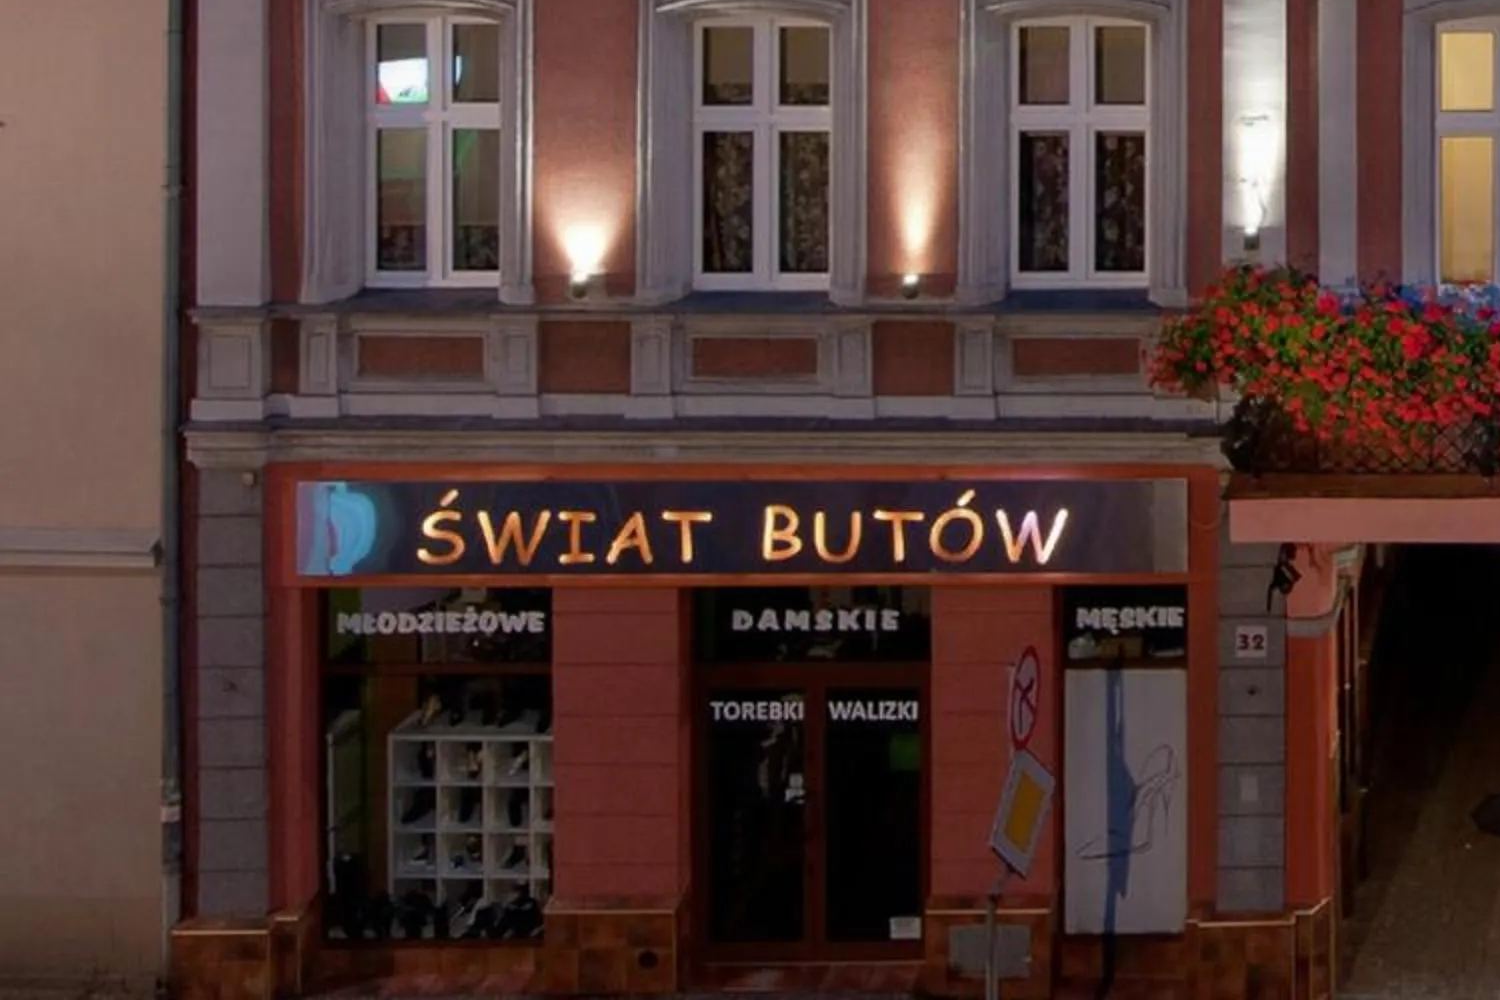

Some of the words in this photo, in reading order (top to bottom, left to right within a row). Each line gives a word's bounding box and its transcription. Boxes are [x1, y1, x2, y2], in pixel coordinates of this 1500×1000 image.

[416, 488, 713, 566] ŚWIAT
[762, 489, 1069, 564] BUTÓW
[336, 604, 545, 634] MŁODZIEŻOWE
[731, 607, 900, 632] DAMSKIE
[1075, 605, 1185, 635] MĘSKIE
[1238, 634, 1264, 650] 32
[709, 700, 805, 721] TOREBKI
[828, 700, 919, 721] WALIZKI
